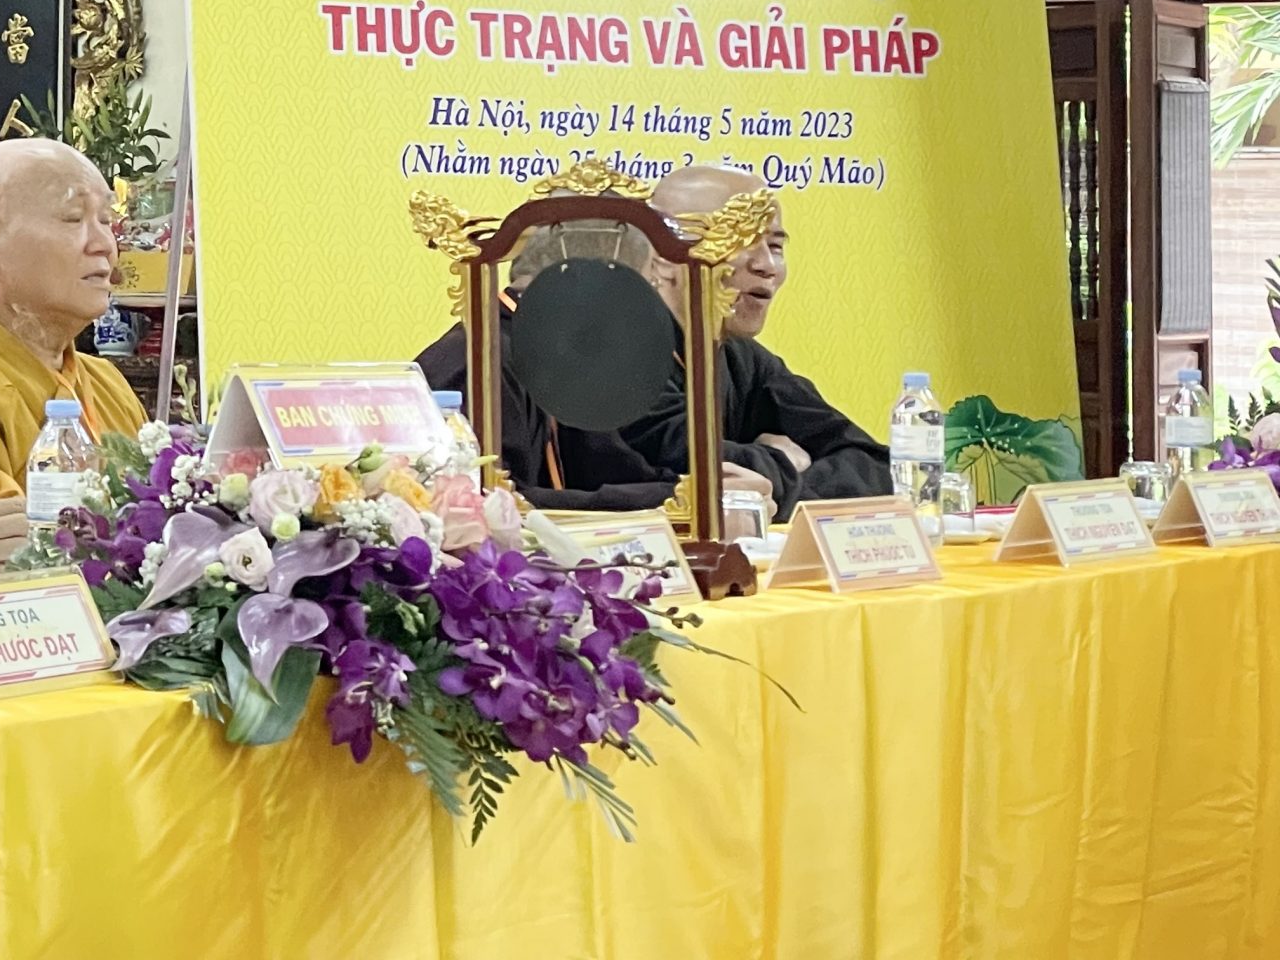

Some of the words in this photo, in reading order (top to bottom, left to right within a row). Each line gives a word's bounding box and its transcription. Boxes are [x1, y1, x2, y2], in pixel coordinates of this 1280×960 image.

[322, 0, 455, 66] THỰC
[470, 12, 629, 72] TRẠNG
[643, 7, 704, 66] VÀ
[719, 6, 806, 70] GIẢI
[823, 17, 939, 75] PHÁP
[429, 97, 470, 127] Hà
[478, 99, 531, 136] Nội,
[540, 103, 600, 137] ngày
[609, 104, 635, 132] 14
[643, 105, 712, 141] tháng
[719, 108, 732, 135] 5
[740, 110, 792, 137] năm
[799, 111, 853, 138] 2023
[402, 139, 490, 179] (Nhằm
[763, 155, 811, 189] Quý
[819, 156, 885, 190] Mão)
[276, 406, 317, 427] BAN
[317, 397, 380, 427] CHỨNG
[7, 608, 40, 629] TỌA
[43, 633, 79, 661] ĐẠT
